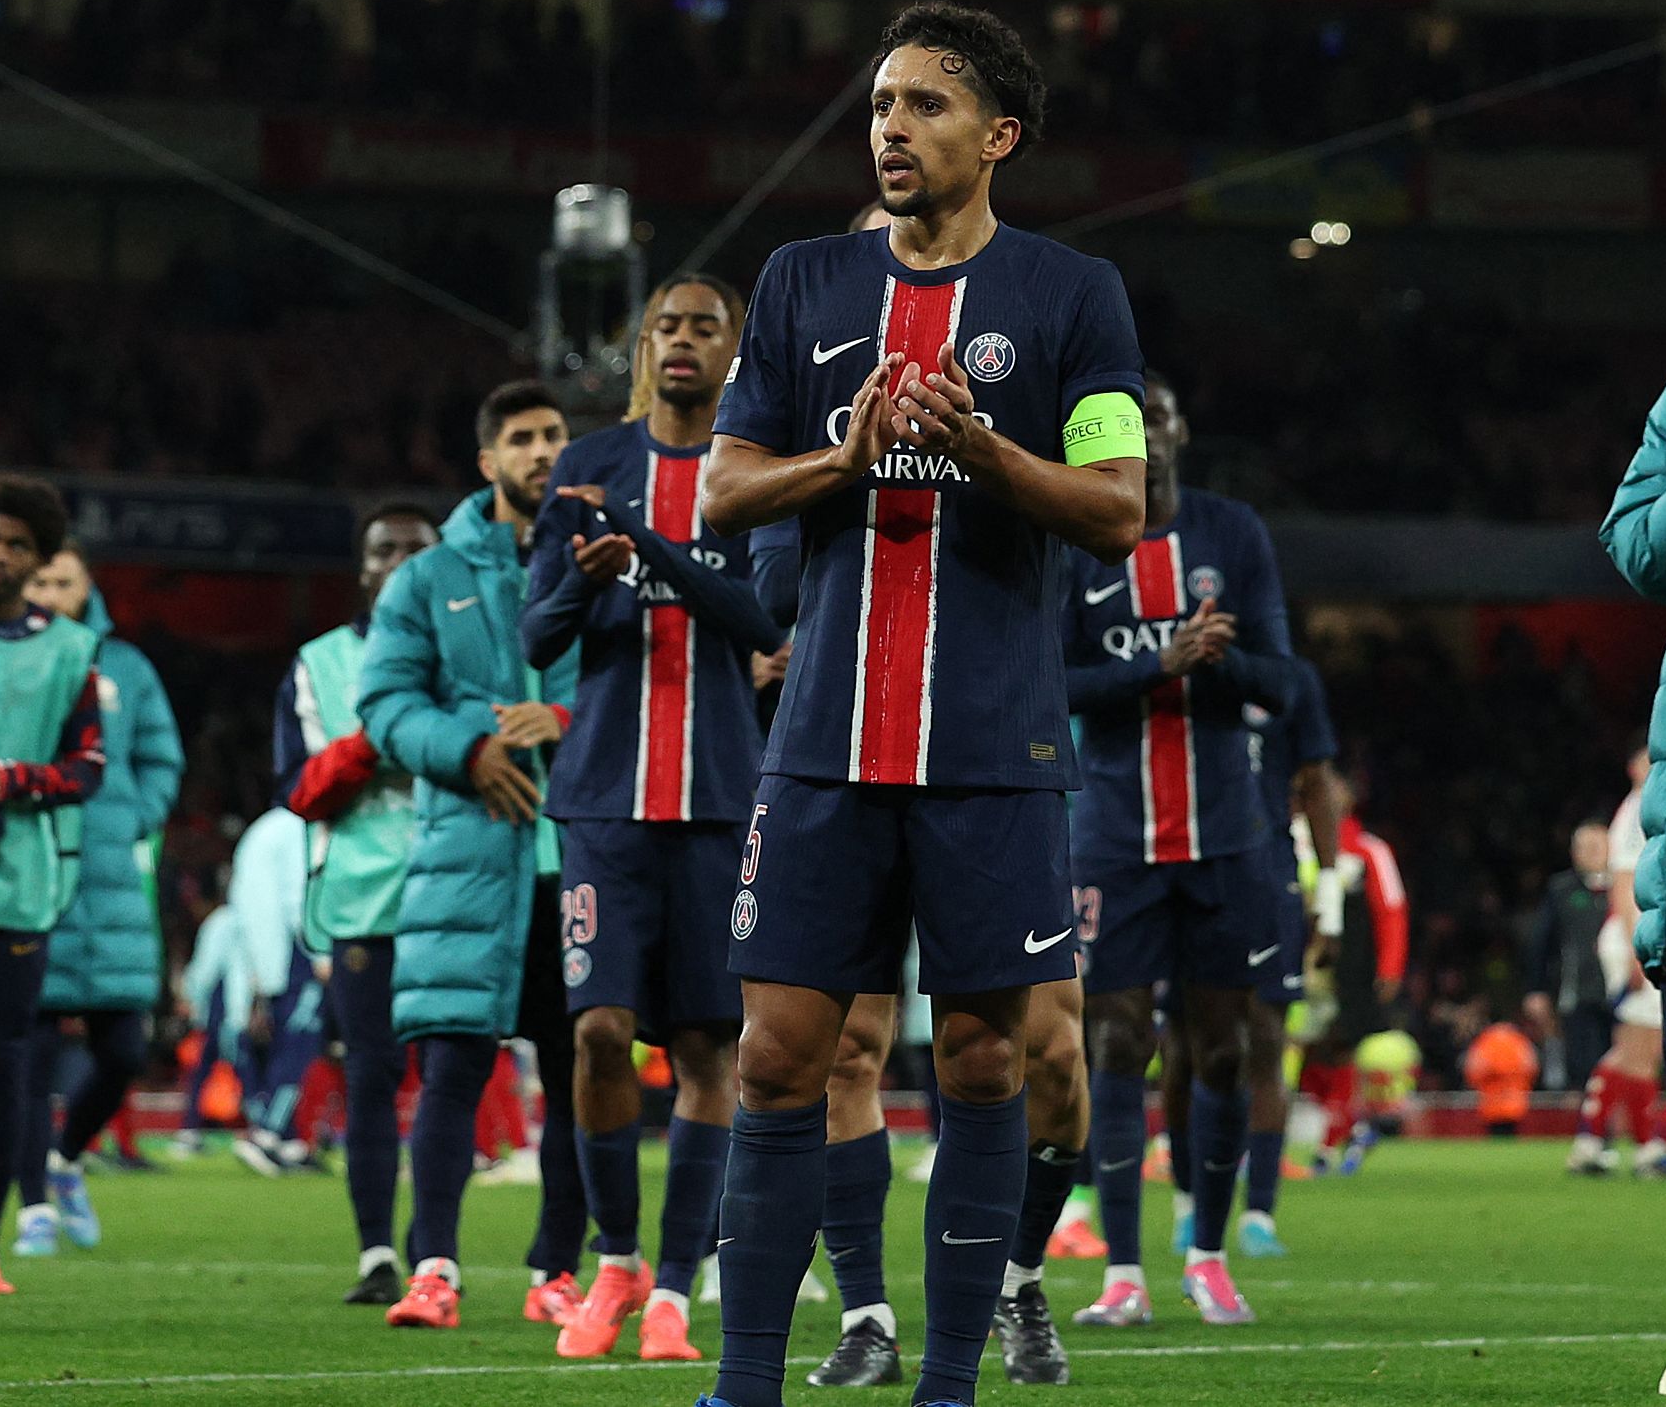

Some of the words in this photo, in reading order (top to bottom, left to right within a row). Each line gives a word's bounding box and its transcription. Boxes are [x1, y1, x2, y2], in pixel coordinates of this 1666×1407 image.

[976, 336, 1008, 349] PARIS
[1102, 618, 1186, 662] QAT
[741, 804, 769, 885] 5
